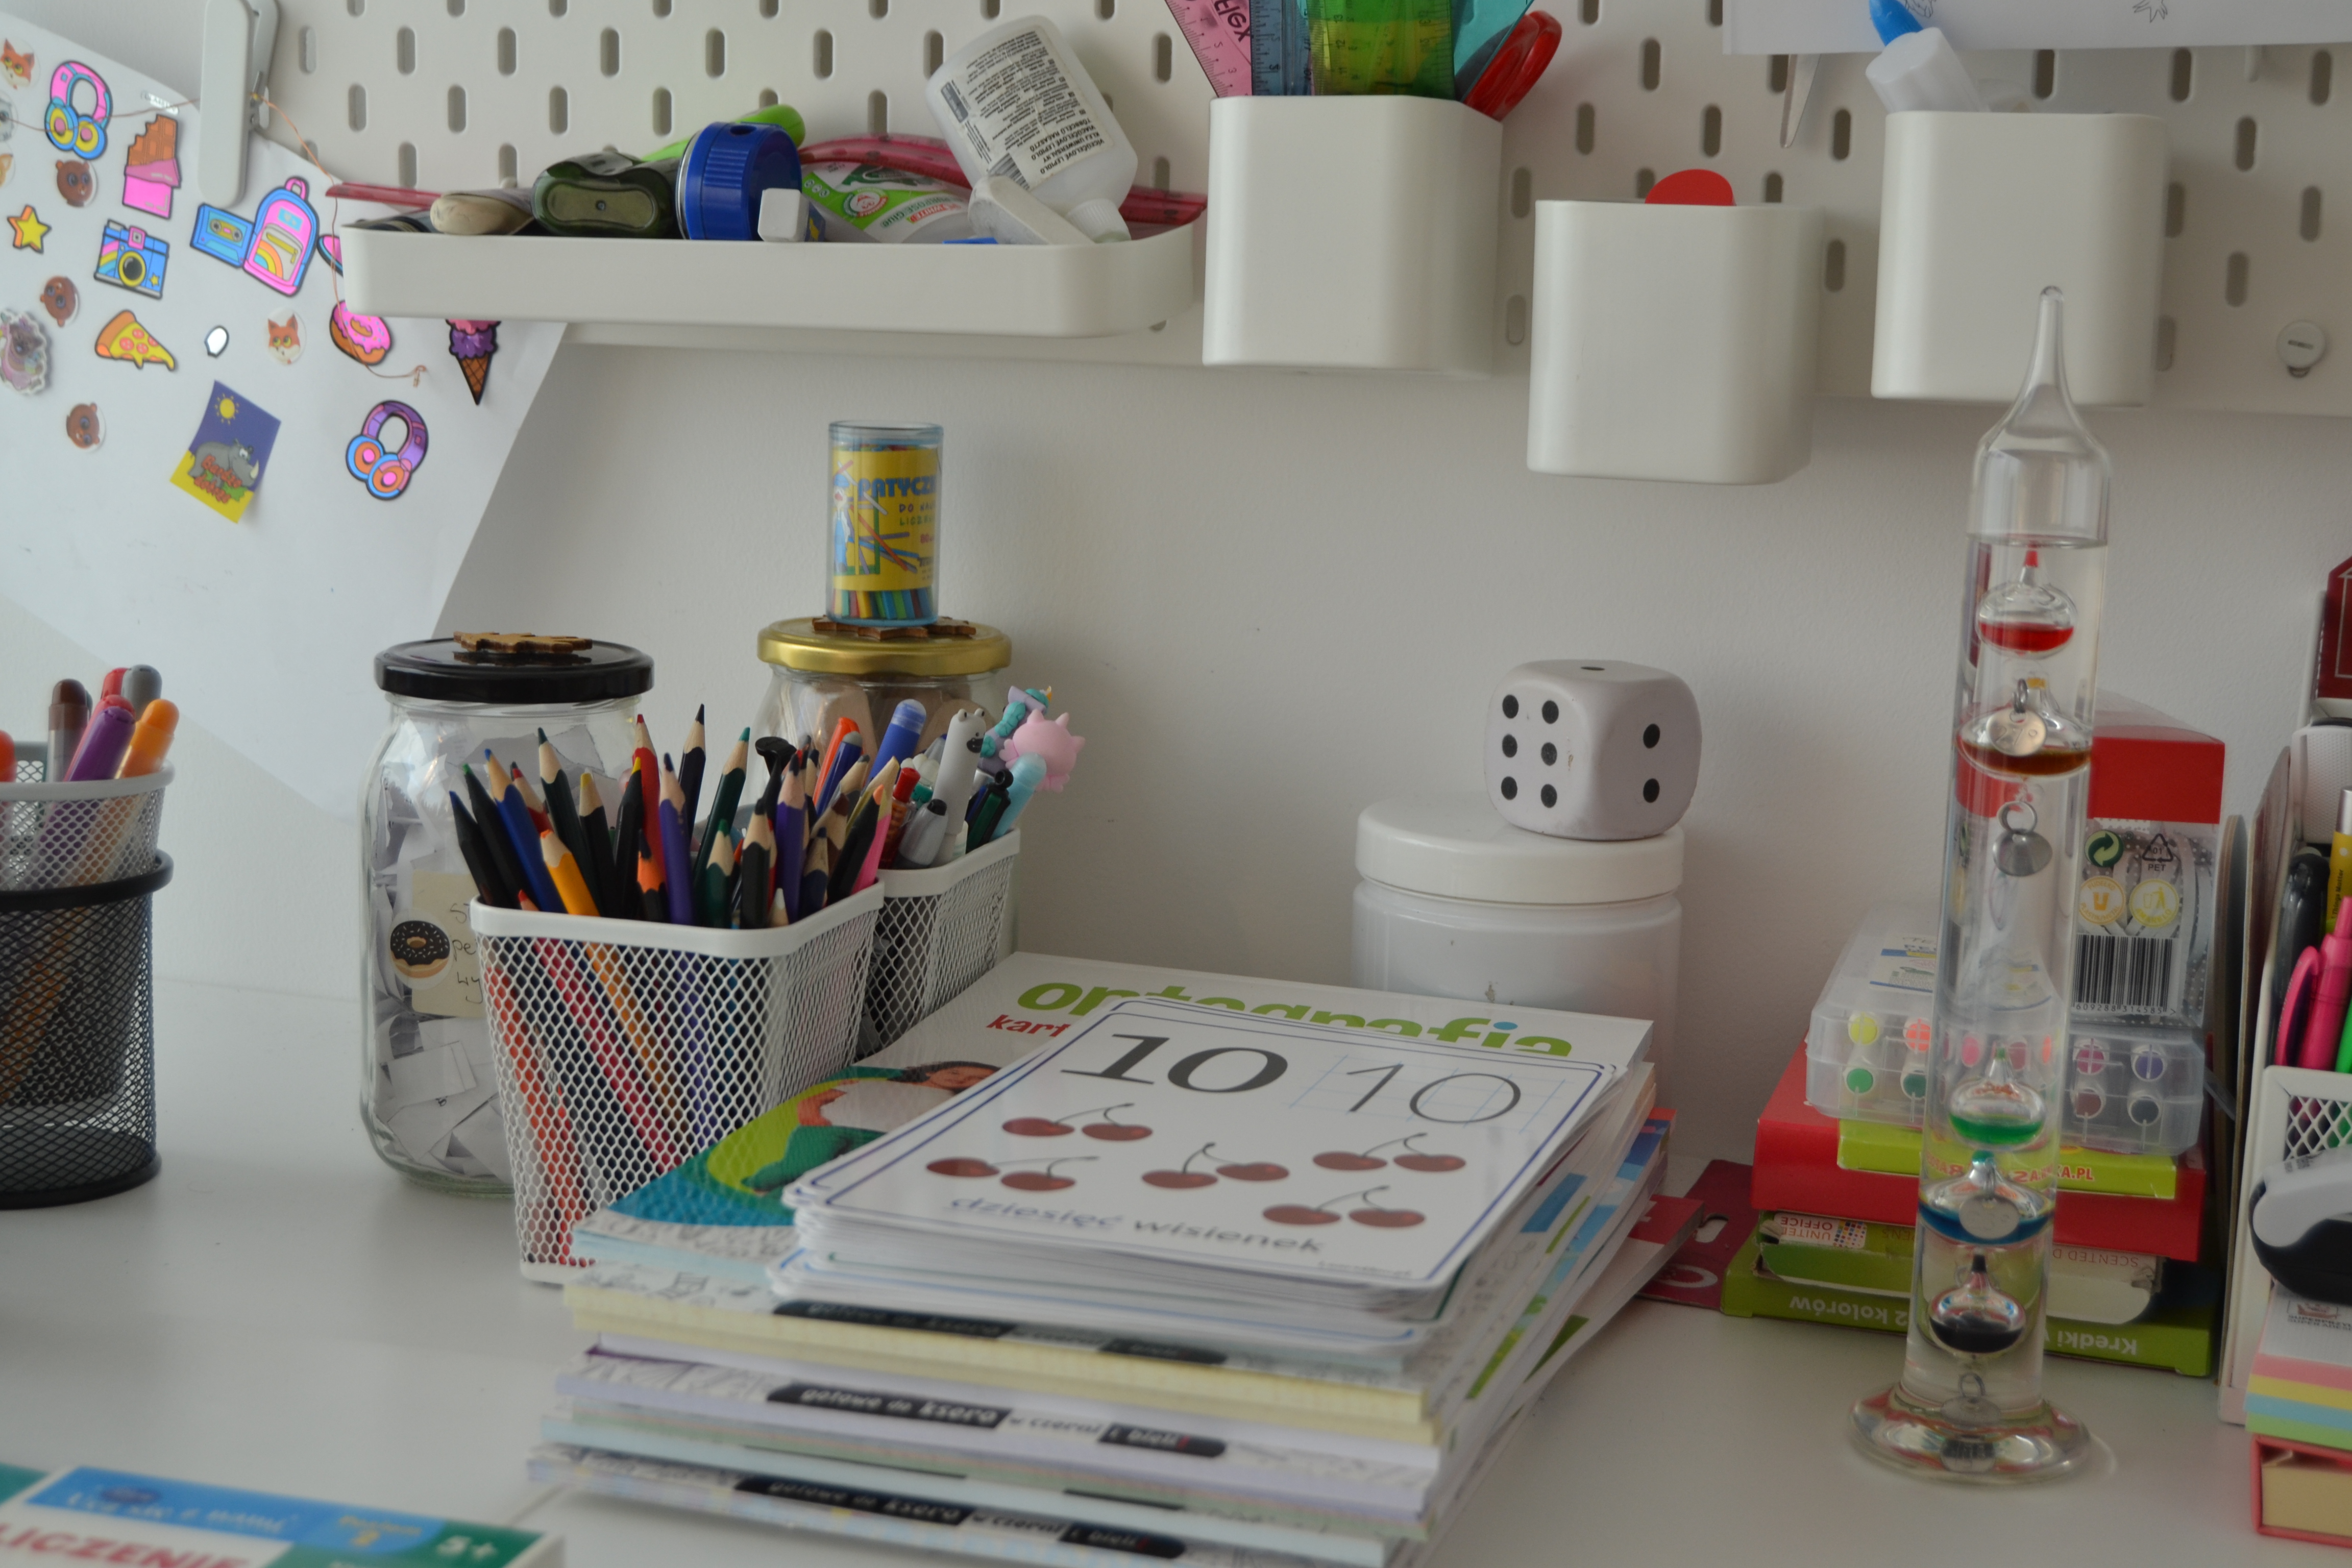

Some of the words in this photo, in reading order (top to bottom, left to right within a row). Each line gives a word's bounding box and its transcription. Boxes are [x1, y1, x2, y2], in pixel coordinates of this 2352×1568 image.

[1040, 156, 1065, 175] LEPIDLO
[899, 503, 914, 513] DO
[2152, 847, 2163, 855] 01
[2148, 863, 2167, 872] PET
[1061, 1032, 1289, 1093] 10
[1345, 1062, 1521, 1124] 10
[1780, 1216, 1833, 1231] OFFICE
[2067, 1250, 2139, 1267] SCENTED
[1789, 1295, 1888, 1326] kolorów
[2057, 1330, 2137, 1356] Kredki
[800, 1388, 883, 1410] gotowe
[0, 1523, 251, 1568] ICZENIE
